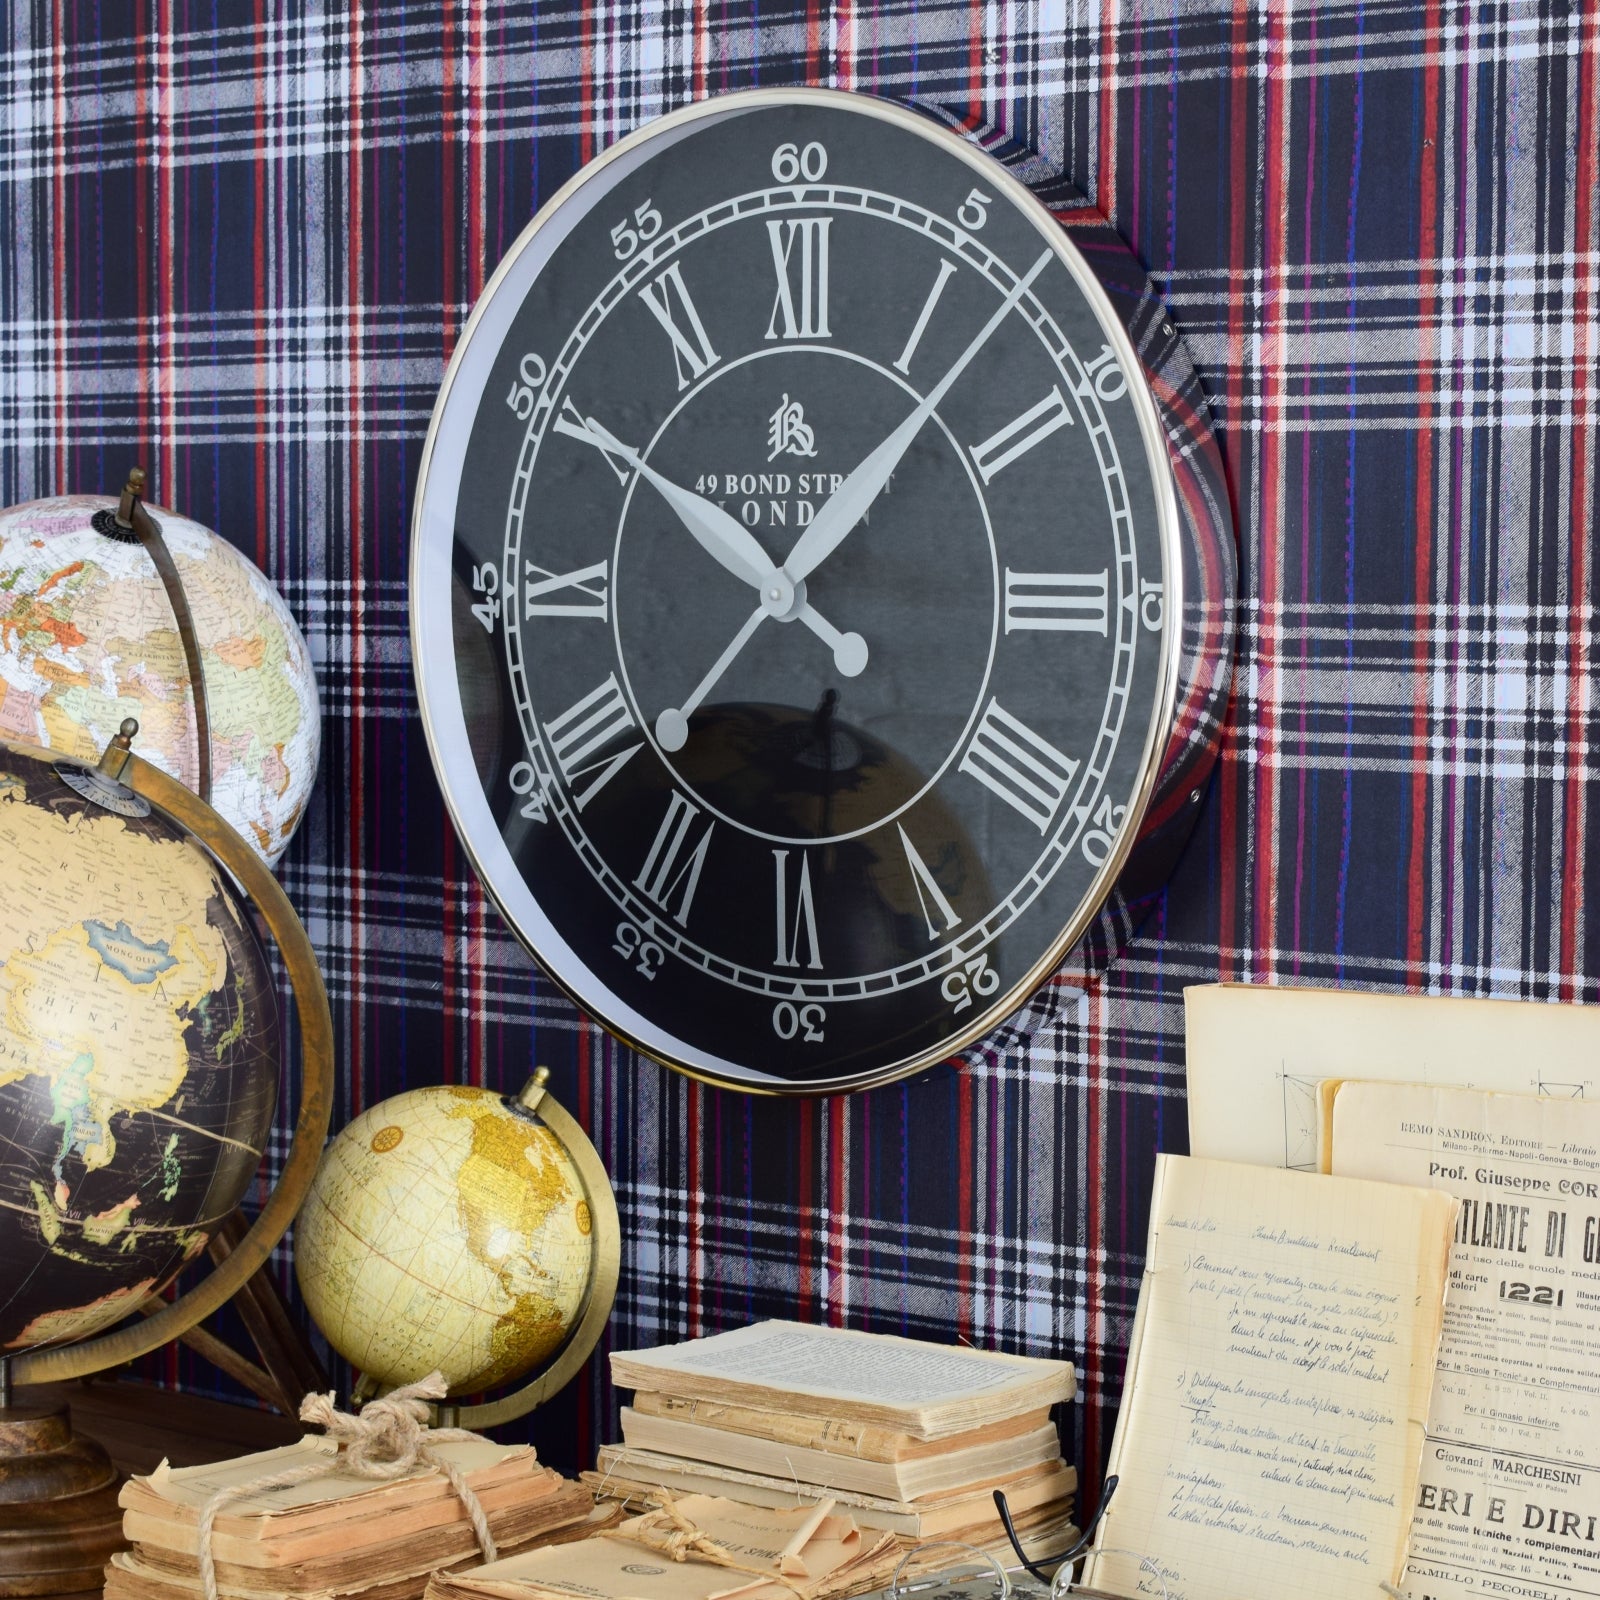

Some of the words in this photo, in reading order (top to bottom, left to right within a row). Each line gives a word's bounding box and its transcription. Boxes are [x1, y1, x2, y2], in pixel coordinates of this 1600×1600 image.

[772, 141, 828, 183] 60
[610, 198, 663, 260] 55
[957, 188, 992, 230] 5
[765, 217, 834, 339] XII
[638, 260, 722, 392] XI
[893, 258, 958, 376] I
[506, 353, 546, 421] 50
[1084, 344, 1128, 402] 10
[553, 395, 640, 487] X
[968, 384, 1074, 486] II
[695, 474, 718, 494] 49
[724, 474, 792, 494] BOND
[798, 473, 895, 494] STRT
[471, 562, 500, 634] 45
[525, 559, 608, 623] IX
[1004, 566, 1108, 638] III
[543, 671, 645, 813] VIII
[958, 696, 1080, 836] IIII
[509, 761, 548, 824] 40
[632, 789, 716, 928] VII
[1081, 794, 1127, 868] 20
[772, 848, 824, 970] VI
[896, 821, 962, 941] V
[104, 943, 158, 965] MONGOLIA
[612, 922, 665, 981] 35
[22, 987, 119, 1032] CHINA
[941, 952, 1000, 1014] 25
[772, 1001, 826, 1043] 30
[1401, 1122, 1433, 1136] REMO
[1561, 1144, 1598, 1156] Libraio
[1429, 1162, 1468, 1180] Prof.
[1475, 1168, 1550, 1192] Giuseppe
[1558, 1178, 1599, 1198] COR
[1545, 1210, 1567, 1258] DI
[1451, 1282, 1477, 1292] colori
[1466, 1272, 1488, 1284] carte
[1474, 1256, 1492, 1264] uso
[1496, 1258, 1524, 1269] delle
[1529, 1264, 1565, 1274] scuole
[1500, 1280, 1564, 1306] 1221
[1436, 1360, 1450, 1369] Per
[1454, 1362, 1461, 1370] le
[1464, 1364, 1490, 1376] Scuole
[1532, 1376, 1536, 1384] e
[1442, 1385, 1454, 1394] Vol.
[1464, 1404, 1476, 1412] Per
[1490, 1409, 1522, 1422] Ginnasio
[1528, 1415, 1560, 1428] inferiore
[1436, 1448, 1482, 1468] Giovanni
[1492, 1458, 1582, 1486] MARCHESINI
[1418, 1483, 1474, 1517] ERI
[1486, 1496, 1506, 1523] E
[1522, 1504, 1597, 1542] DIRI
[1428, 1518, 1444, 1528] delle
[1448, 1522, 1469, 1534] scuole
[1474, 1526, 1512, 1542] tecniche
[1524, 1538, 1600, 1560] complementari
